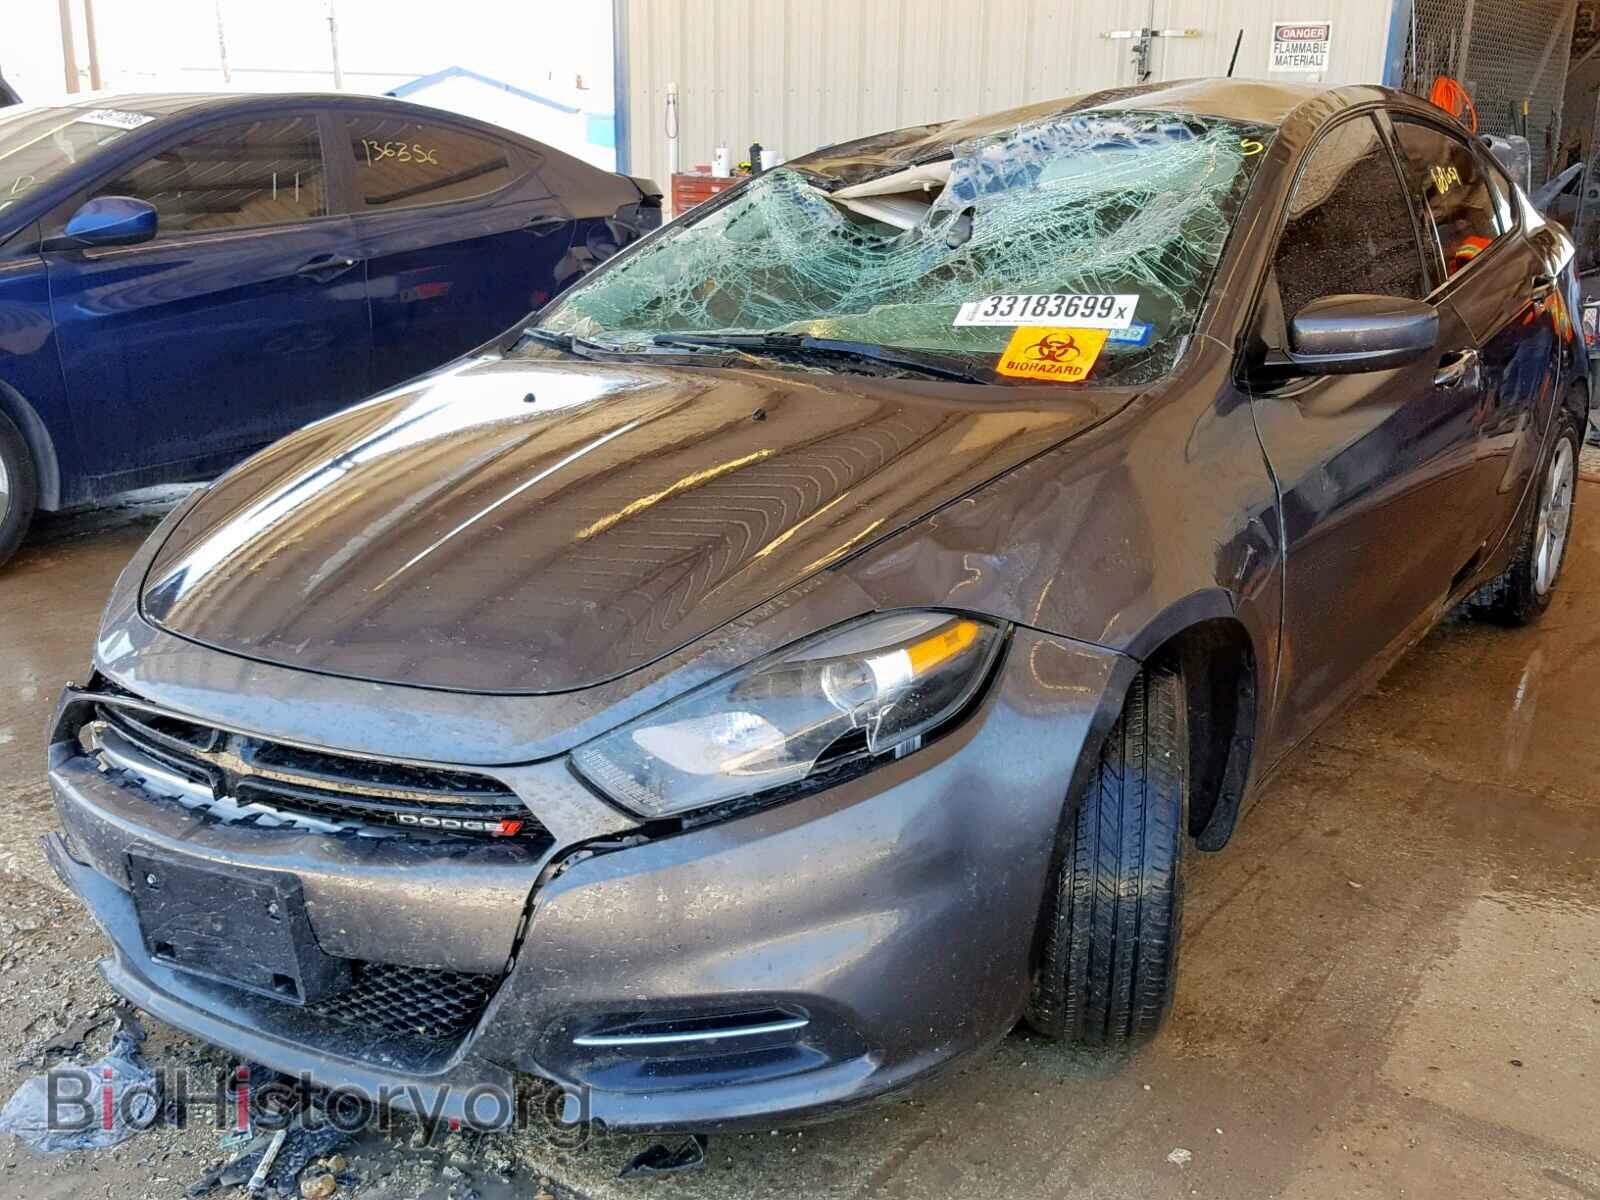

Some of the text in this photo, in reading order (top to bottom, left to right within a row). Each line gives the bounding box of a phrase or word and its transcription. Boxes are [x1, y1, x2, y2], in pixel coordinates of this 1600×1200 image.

[1283, 29, 1326, 39] DANGER
[1274, 42, 1328, 54] FLAMMABLE
[1005, 360, 1084, 376] BIOHAZARD
[399, 814, 505, 832] DODGE
